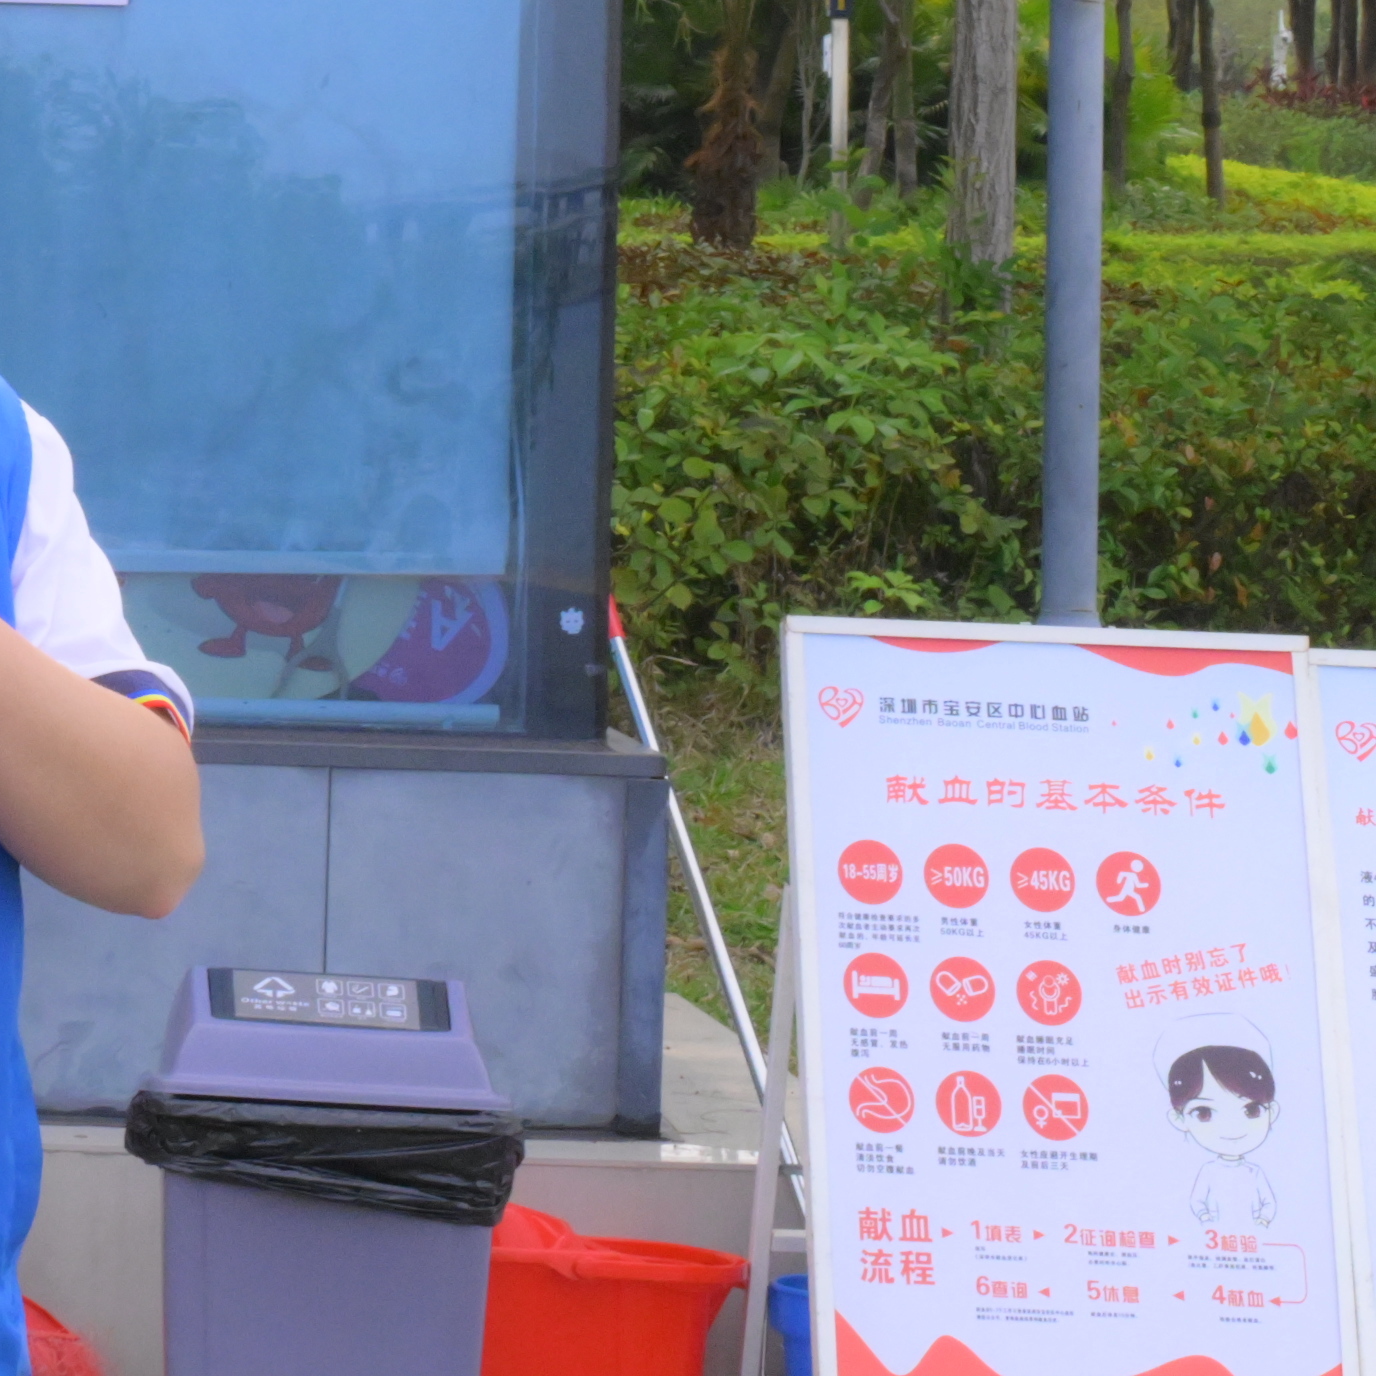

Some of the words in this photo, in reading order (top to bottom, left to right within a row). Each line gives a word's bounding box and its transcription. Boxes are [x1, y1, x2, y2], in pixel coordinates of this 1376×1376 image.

[879, 696, 1090, 723] 深圳市宝安区中心血站
[878, 714, 933, 727] Shenzhen
[937, 717, 972, 729] Baoan
[976, 719, 1017, 731] Central
[1018, 720, 1049, 732] Blood
[1051, 721, 1090, 734] Station
[885, 774, 1227, 819] 献血的基本条件
[842, 862, 899, 884] 18-55周岁
[940, 916, 978, 927] 男性体重
[1024, 920, 1062, 931] 女性体重
[1113, 923, 1151, 934] 身体健康
[1116, 942, 1247, 985] 献血时别忘了
[850, 1027, 898, 1038] 献血前一周
[941, 1031, 990, 1042] 献血前一周
[858, 1207, 933, 1244] 献血
[970, 1219, 1022, 1244] 1填表
[1063, 1223, 1156, 1250] 2征询检查
[1205, 1229, 1258, 1253] 3检验
[860, 1249, 936, 1286] 流程
[975, 1275, 1028, 1300] 6查询
[1086, 1280, 1140, 1304] 5休息
[1211, 1285, 1265, 1309] 4献血
